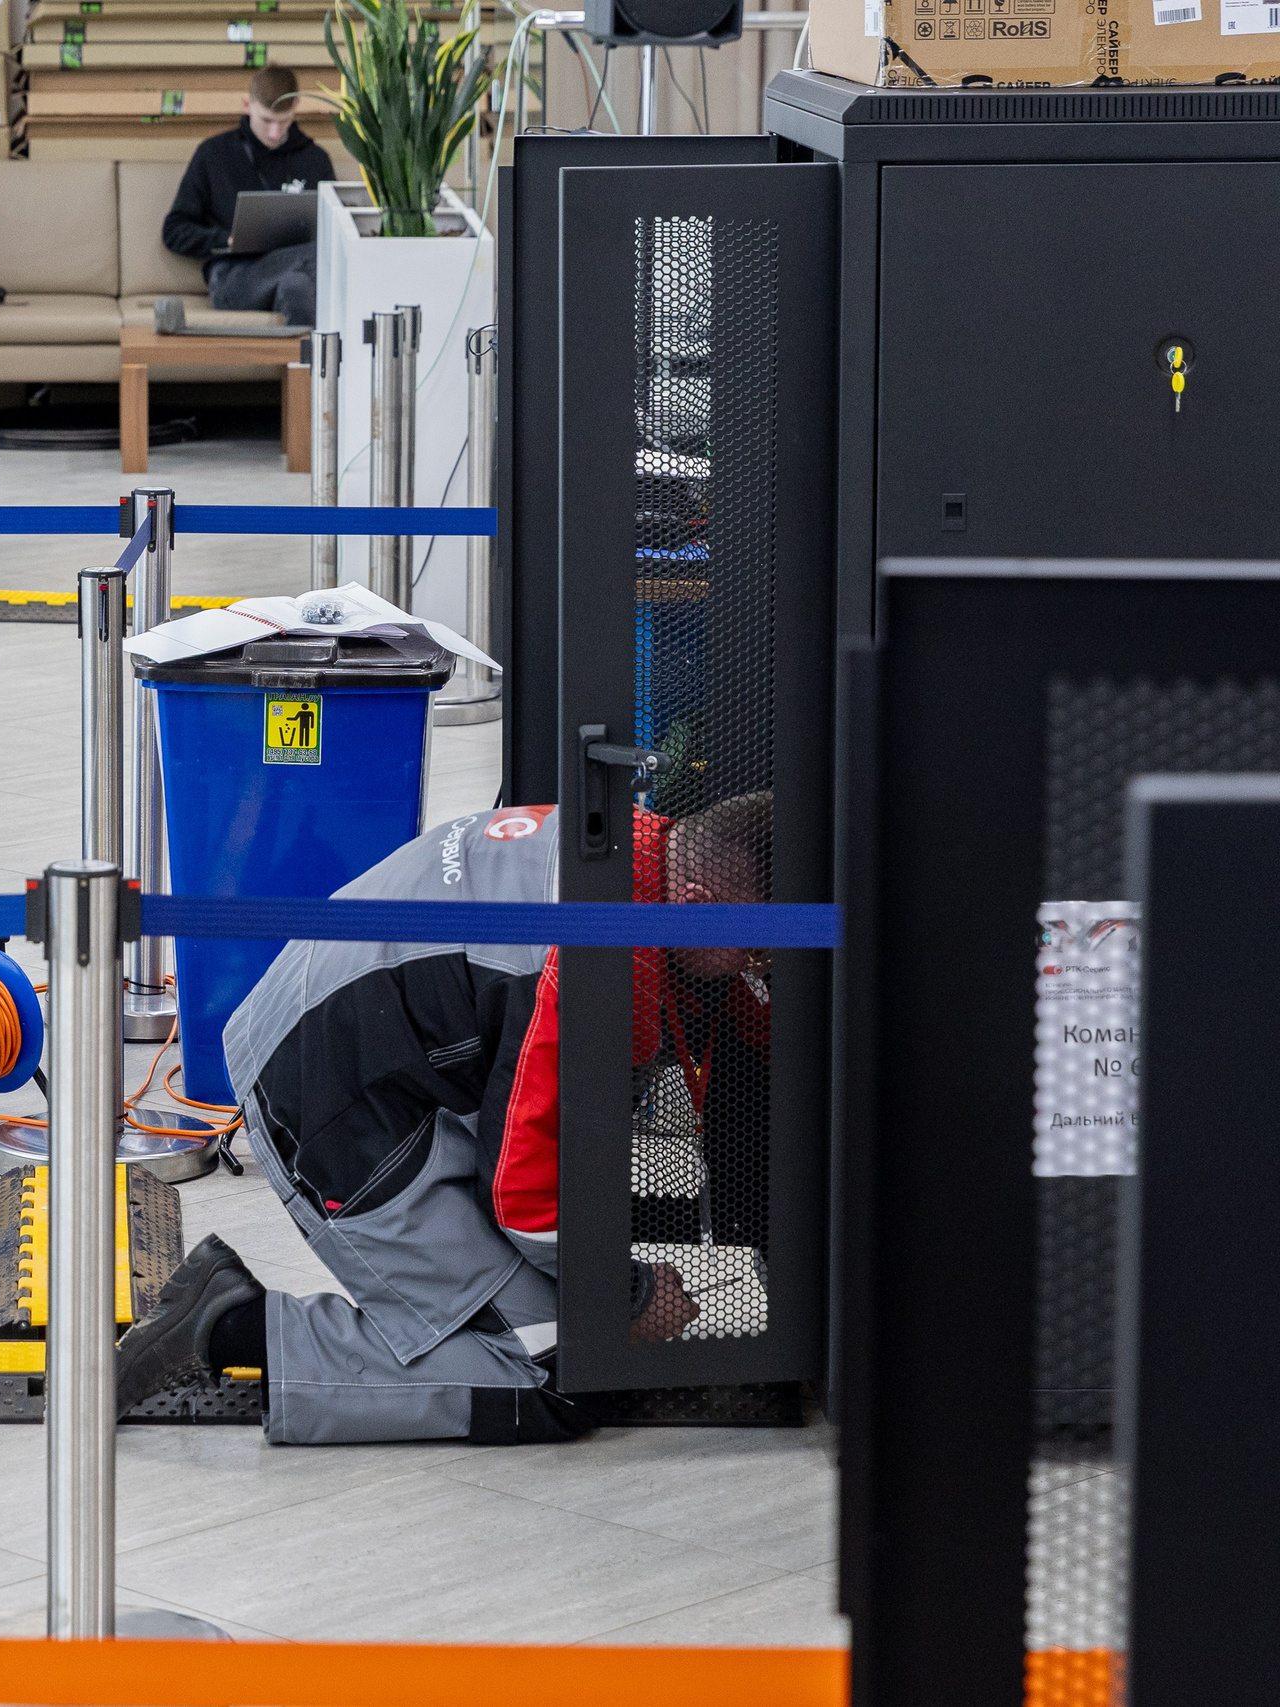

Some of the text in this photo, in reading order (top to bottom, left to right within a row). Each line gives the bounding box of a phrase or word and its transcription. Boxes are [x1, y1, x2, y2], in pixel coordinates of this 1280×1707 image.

[992, 20, 1048, 37] RoHS
[1097, 19, 1106, 75] ЭЛЕКТРО
[1109, 20, 1120, 75] САЙБЕР
[1050, 1111, 1124, 1130] Дальний
